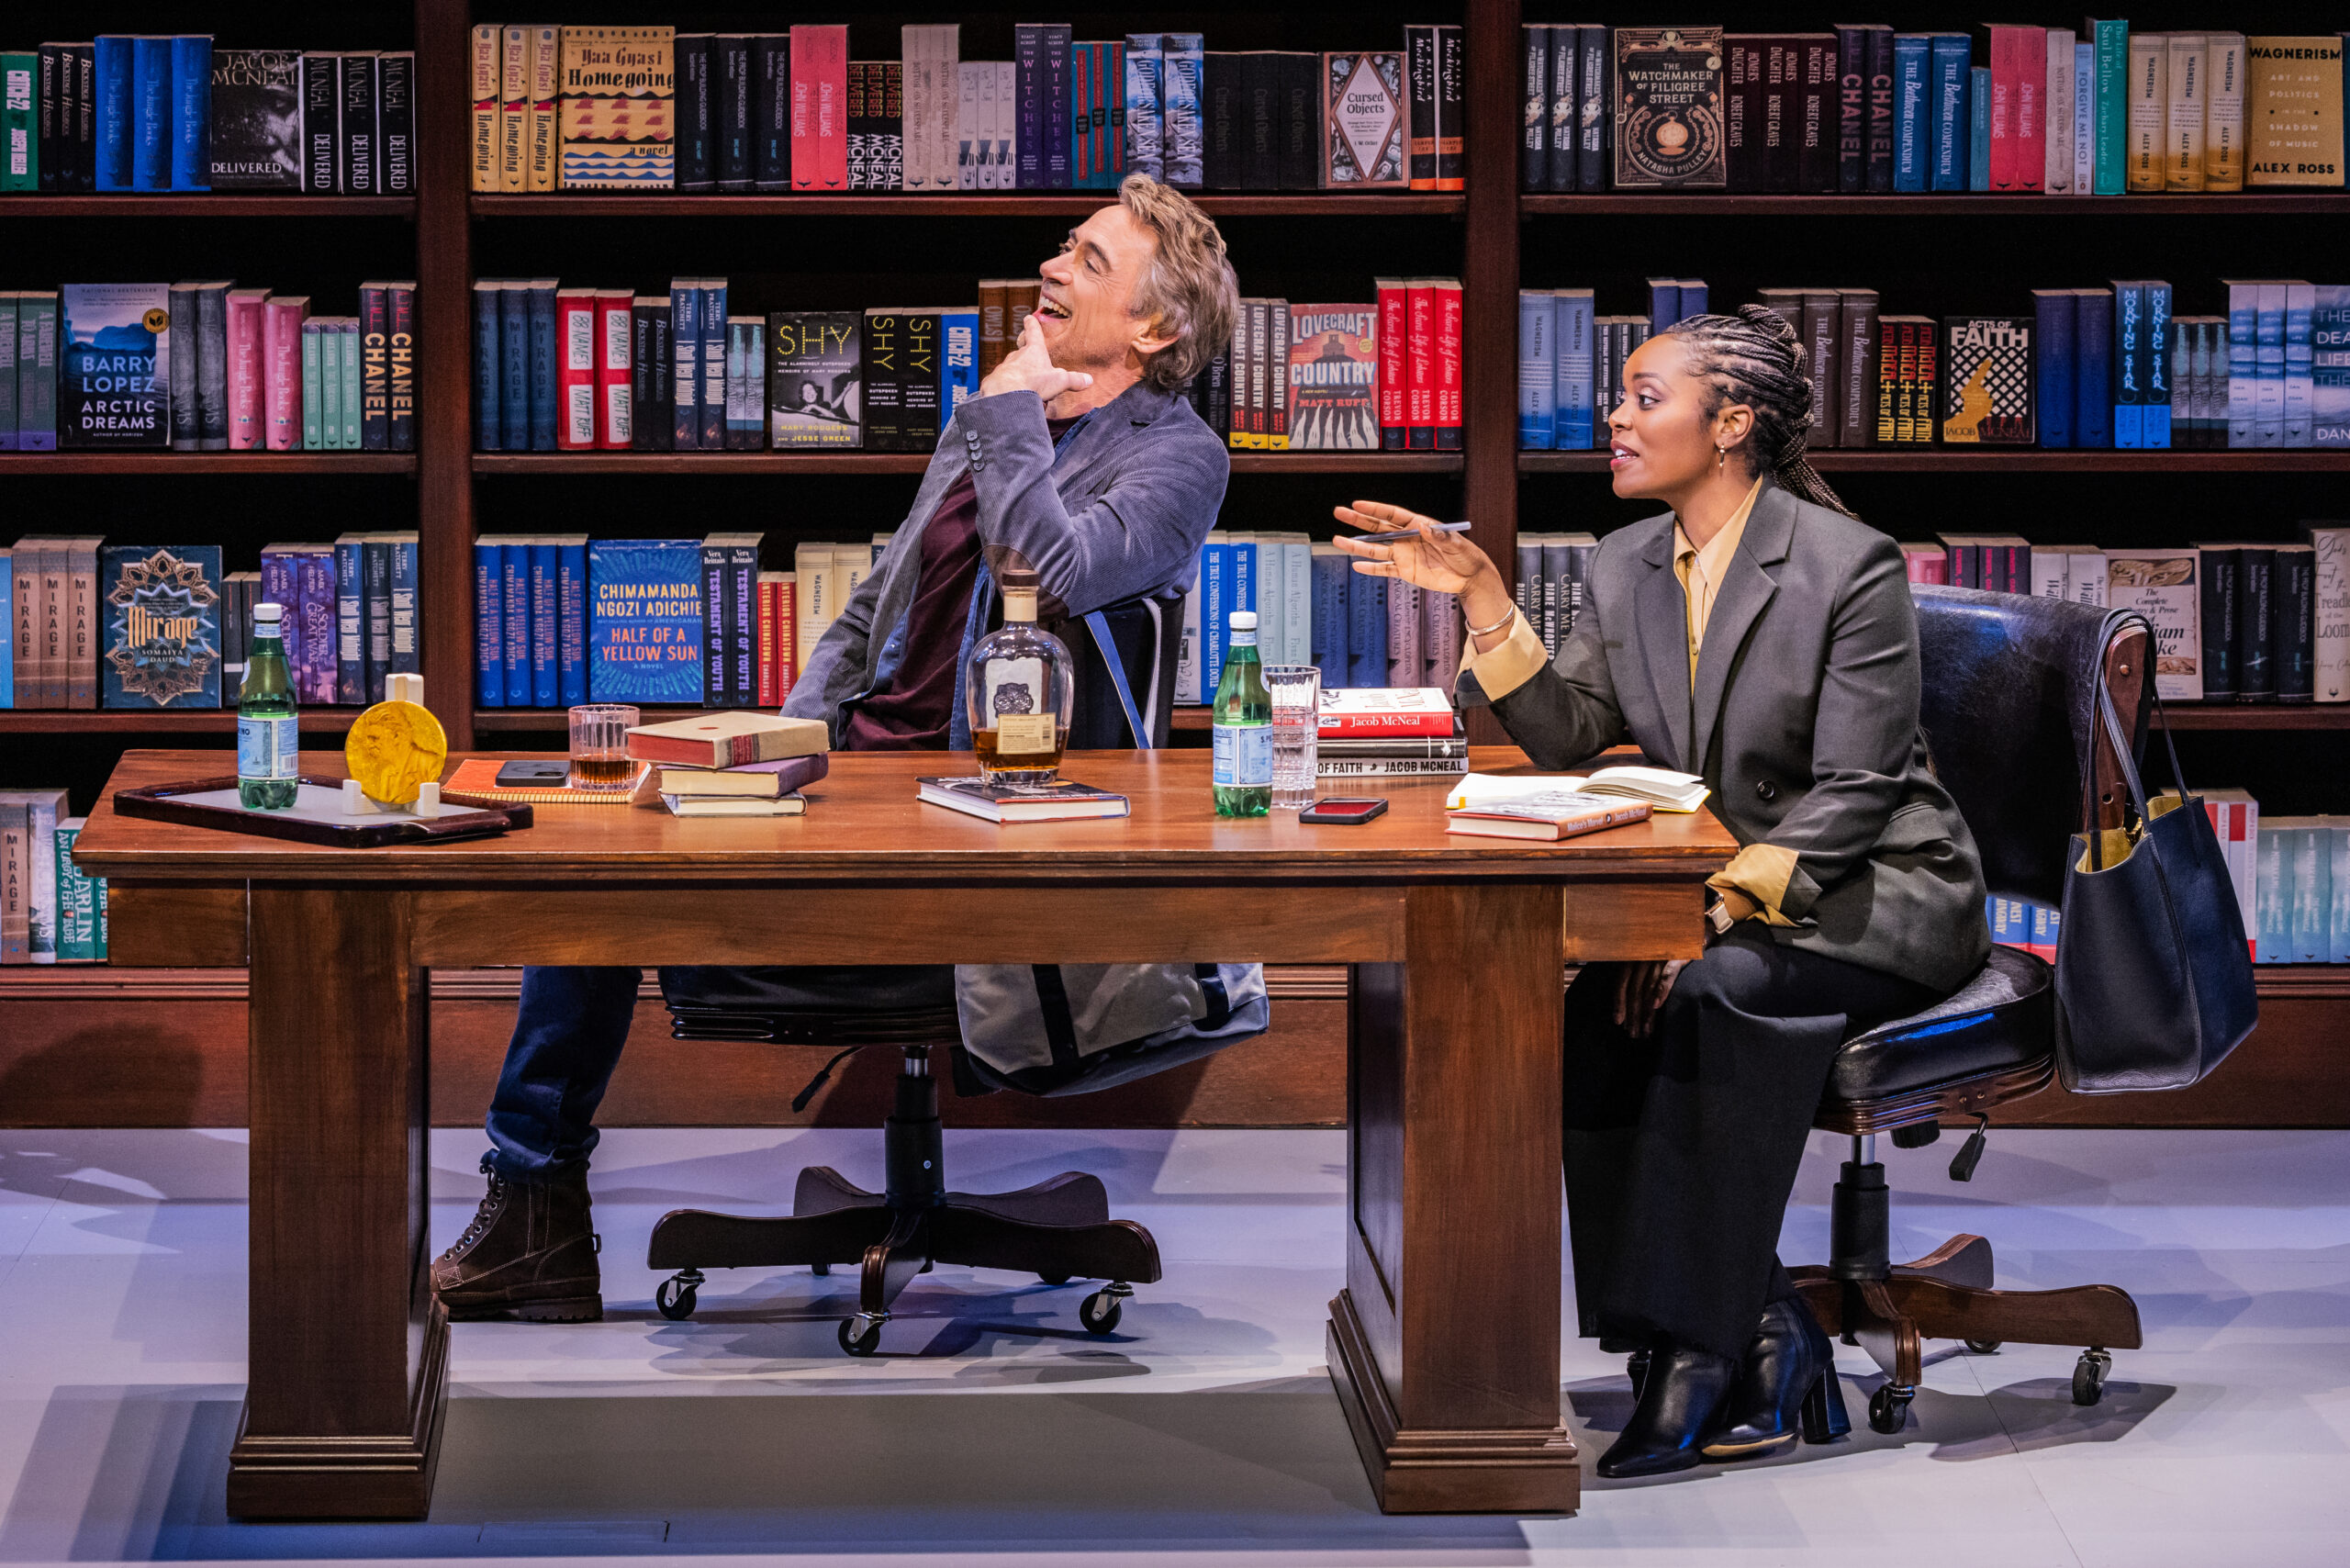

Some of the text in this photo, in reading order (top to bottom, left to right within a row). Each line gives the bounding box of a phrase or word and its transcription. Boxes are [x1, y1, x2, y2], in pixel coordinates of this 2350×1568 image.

[222, 53, 290, 71] JACOB
[582, 47, 662, 66] Yaa Gyasi
[1413, 37, 1426, 102] Mockingbird
[1662, 62, 1681, 71] THE
[1731, 47, 1744, 84] DAUGHTER
[2101, 25, 2112, 94] Saul Bellow
[2248, 47, 2343, 61] WAGNERISM
[211, 70, 299, 86] MCNEAL
[568, 67, 675, 89] Homegoing
[848, 63, 865, 118] DELIVERED
[1628, 70, 1715, 82] WATCHMAKER
[1651, 82, 1707, 93] FILIGREE
[2185, 56, 2197, 98] WAGNERISM
[819, 81, 834, 138] JOHN WILLIAMS
[1022, 59, 1035, 151] WITCHES
[1176, 60, 1197, 137] GODFORSAKEN
[1346, 102, 1385, 115] Objects
[1347, 91, 1383, 103] Cursed
[1649, 94, 1695, 104] STREET
[2268, 91, 2321, 99] POLITICS
[310, 59, 331, 189] MCNEAL DELIVERED
[385, 59, 408, 190] MCNEAL DELIVERED
[1729, 95, 1744, 148] ROBERT GRAVES
[1840, 73, 1863, 163] CHANEL
[1871, 74, 1892, 163] CHANEL
[1901, 61, 1922, 174] THE Beethoven COMPENDIUM
[2077, 71, 2088, 167] FORGIVE ME NOT
[2268, 124, 2320, 132] SHADOW
[476, 114, 493, 172] Homegoing
[533, 115, 551, 173] Homegoing
[1177, 139, 1197, 161] SEA
[2099, 101, 2110, 170] Zachary Leader
[211, 162, 283, 174] DELIVERED
[867, 132, 886, 190] MCNEAL
[1637, 150, 1708, 175] NATASHA PULLEY
[2253, 162, 2336, 174] ALEX ROSS
[708, 293, 716, 331] PRATCHETT
[983, 305, 1004, 338] OWLS
[1967, 320, 2012, 329] ACTS OF
[777, 325, 852, 355] SHY
[871, 316, 895, 372] SHY
[1292, 312, 1378, 346] LOVECRAFT
[1950, 328, 2030, 348] FAITH
[2122, 290, 2142, 391] MORNING STAR
[509, 320, 522, 399] MIRAGE
[946, 326, 972, 367] CATCH-22
[1272, 307, 1286, 410] LOVECRAFT COUNTRY
[82, 355, 157, 373] BARRY
[364, 332, 386, 422] CHANEL
[610, 314, 632, 438] 88 NAMES MATT RUFF
[1212, 356, 1226, 387] O'Brien
[1290, 361, 1376, 386] COUNTRY
[82, 376, 155, 393] LOPEZ
[81, 399, 156, 413] ARCTIC
[1298, 398, 1370, 409] MATT RUFF
[1410, 389, 1420, 420] CORSON
[1421, 389, 1431, 420] TREVOR
[82, 416, 156, 430] DREAMS
[1945, 425, 2031, 438] JACOB MCNEAL
[703, 556, 726, 566] Brittain
[599, 583, 699, 599] CHIMAMANDA
[761, 581, 772, 617] INTERIOR
[813, 574, 823, 615] WAGNERISM
[1560, 573, 1572, 631] CARRY ME
[2135, 597, 2168, 605] Complete
[2145, 588, 2159, 596] The
[19, 577, 31, 657] MIRAGE
[75, 577, 86, 657] MIRAGE
[561, 566, 573, 672] CHIMAMANDA NGOZI ADICHIE
[596, 600, 703, 617] NGOZI ADICHIE
[1208, 552, 1221, 689] THE TRUE CONFESSIONS OF CHARLOTTE DOYLE
[1290, 591, 1301, 627] Algorithm
[1393, 578, 1404, 655] MAGICAL CREATURES
[1544, 582, 1556, 660] DIANE McWHORTER
[2159, 606, 2178, 614] Prose
[128, 607, 198, 649] Mirage
[305, 601, 319, 664] GREAT WAR
[610, 627, 686, 644] HALF OF A
[709, 569, 724, 691] TESTAMENT OF YOUTH
[762, 619, 772, 662] CHINATOWN
[2316, 617, 2350, 638] Loom
[140, 648, 185, 656] SOMAIYA
[601, 645, 699, 661] YELLOW SUN
[763, 664, 772, 688] CHARLES
[1349, 714, 1421, 728] Jacob McNeal
[1317, 760, 1464, 774] OF FAITH JACOB MCNEAL
[6, 833, 18, 913] MIRAGE
